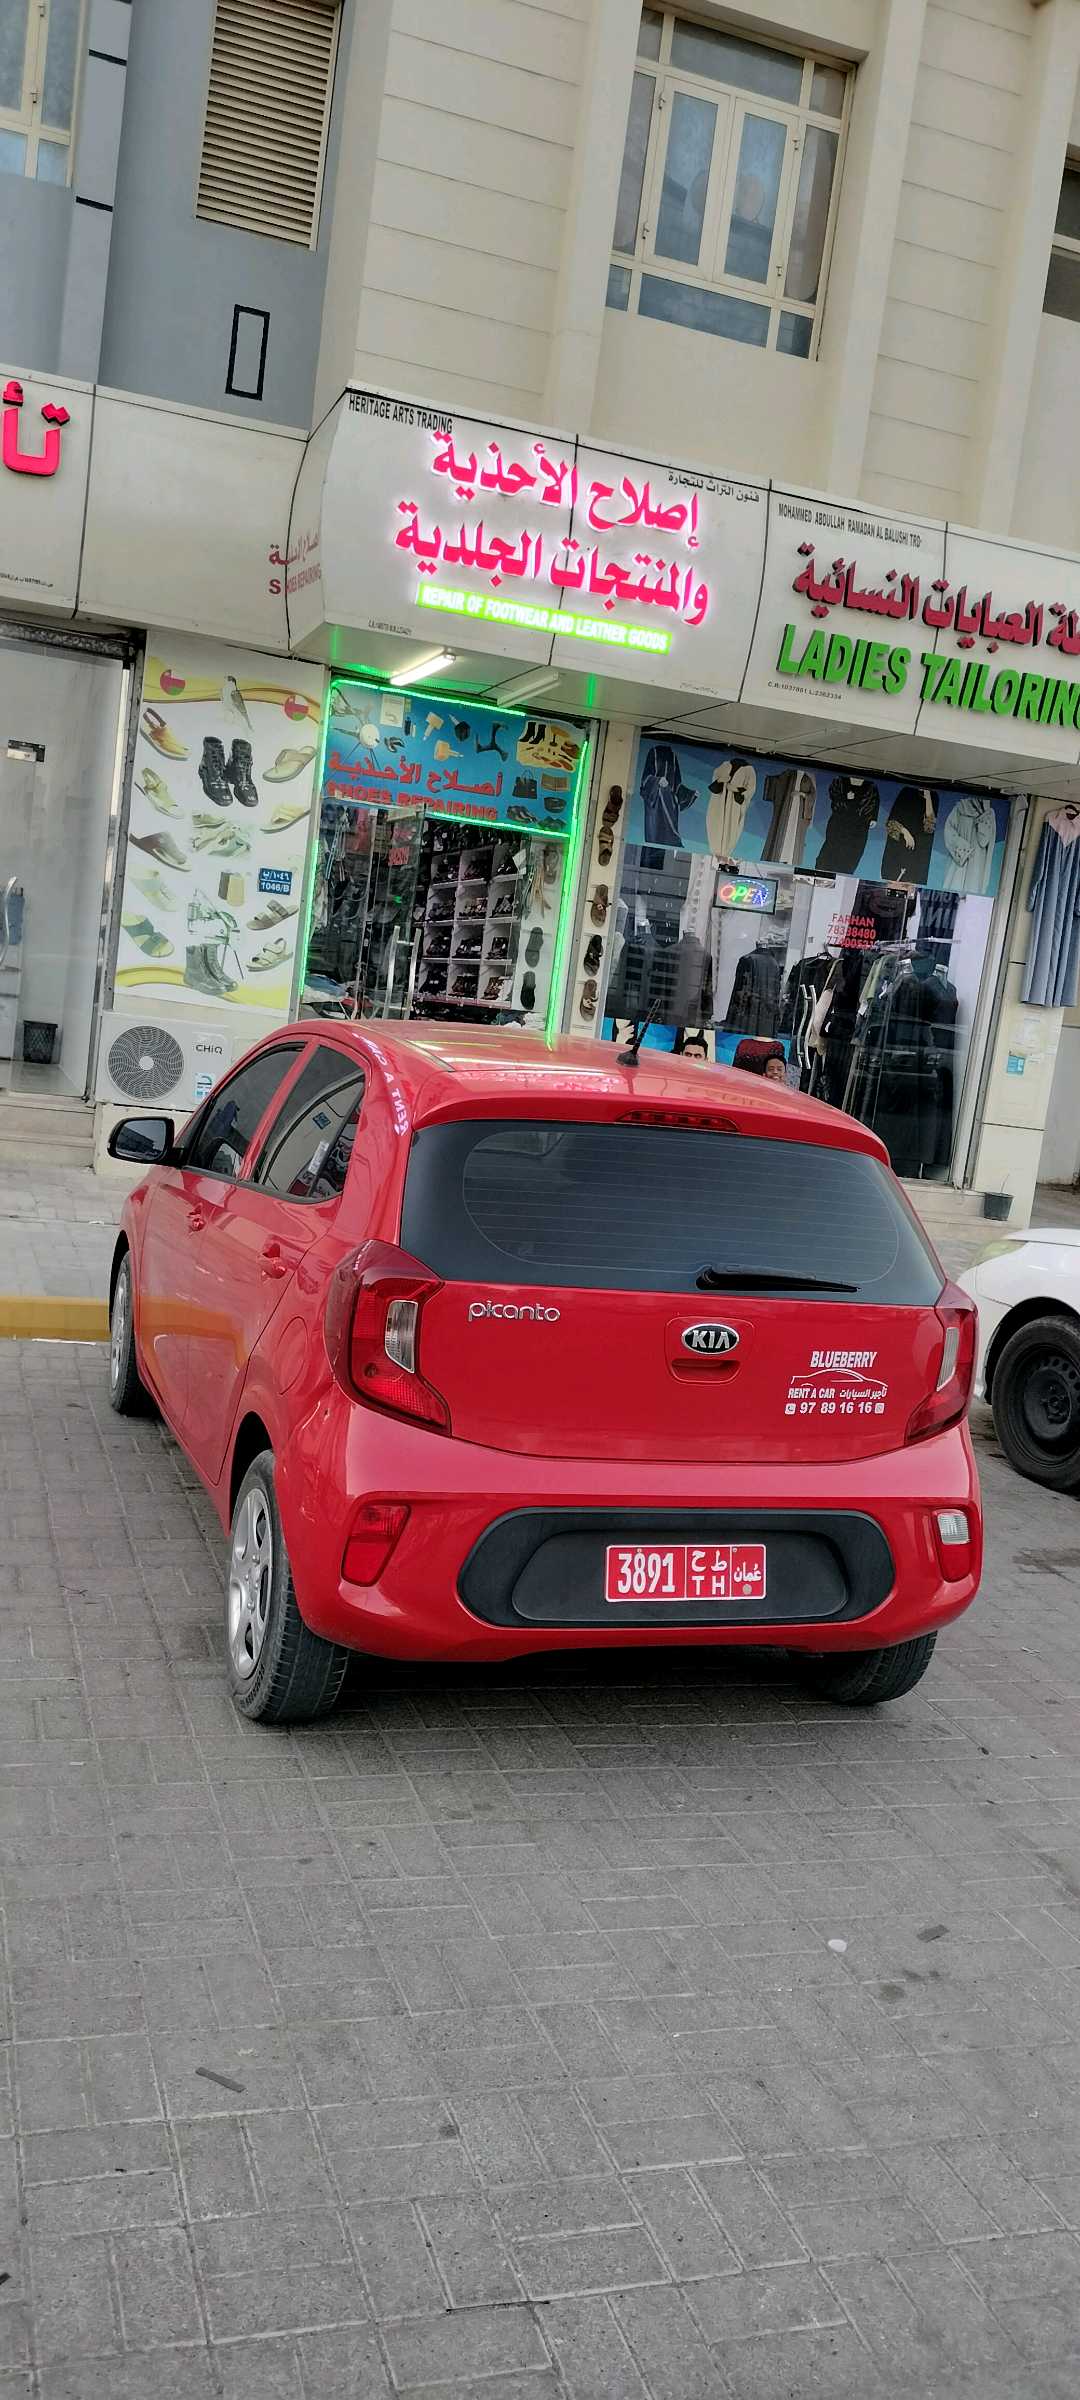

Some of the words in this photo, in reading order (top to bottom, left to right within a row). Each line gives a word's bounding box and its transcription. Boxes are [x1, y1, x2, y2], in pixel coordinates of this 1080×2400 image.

[349, 395, 390, 419] HERITAGE
[392, 406, 415, 425] ARTS
[416, 411, 453, 434] TRADING
[433, 430, 579, 508] الأحذية
[668, 471, 704, 489] للتجارة
[706, 480, 734, 496] التراث
[736, 490, 760, 503] فنون
[588, 476, 701, 549] إصلاح
[778, 503, 813, 524] MOHAMMED
[815, 511, 845, 529] ABDULLAH
[848, 519, 875, 537] RAMADAN
[876, 526, 883, 539] AL
[884, 528, 908, 544] BALUSHI
[394, 500, 543, 588] الجلدية
[550, 537, 708, 626] والمنتجات
[793, 542, 920, 619] النسائية
[423, 586, 464, 611] REPAIR
[466, 596, 484, 613] OF
[485, 600, 549, 628] FOOTWEAR
[549, 611, 574, 633] AND
[576, 616, 627, 642] LEATHER
[628, 628, 669, 650] GOODS
[922, 579, 1043, 653] العبايات
[776, 624, 911, 694] LADIES
[396, 793, 497, 821] REPAIRING
[261, 881, 290, 892] 1046/B
[720, 884, 768, 907] OPEN
[832, 913, 875, 927] FARHAN
[468, 1301, 560, 1322] picanto
[692, 1330, 730, 1349] KIA
[810, 1350, 877, 1368] BLUEBERRY
[788, 1388, 811, 1399] RENT
[810, 1388, 817, 1399] A
[818, 1388, 835, 1399] CAR
[839, 1388, 870, 1400] السيارات
[799, 1402, 816, 1414] 97
[821, 1402, 836, 1414] 89
[840, 1402, 855, 1414] 16
[859, 1402, 873, 1414] 16
[691, 1550, 707, 1572] ح
[711, 1550, 728, 1572] ط
[617, 1552, 676, 1594] 3891
[691, 1575, 705, 1595] T
[711, 1575, 725, 1595] H
